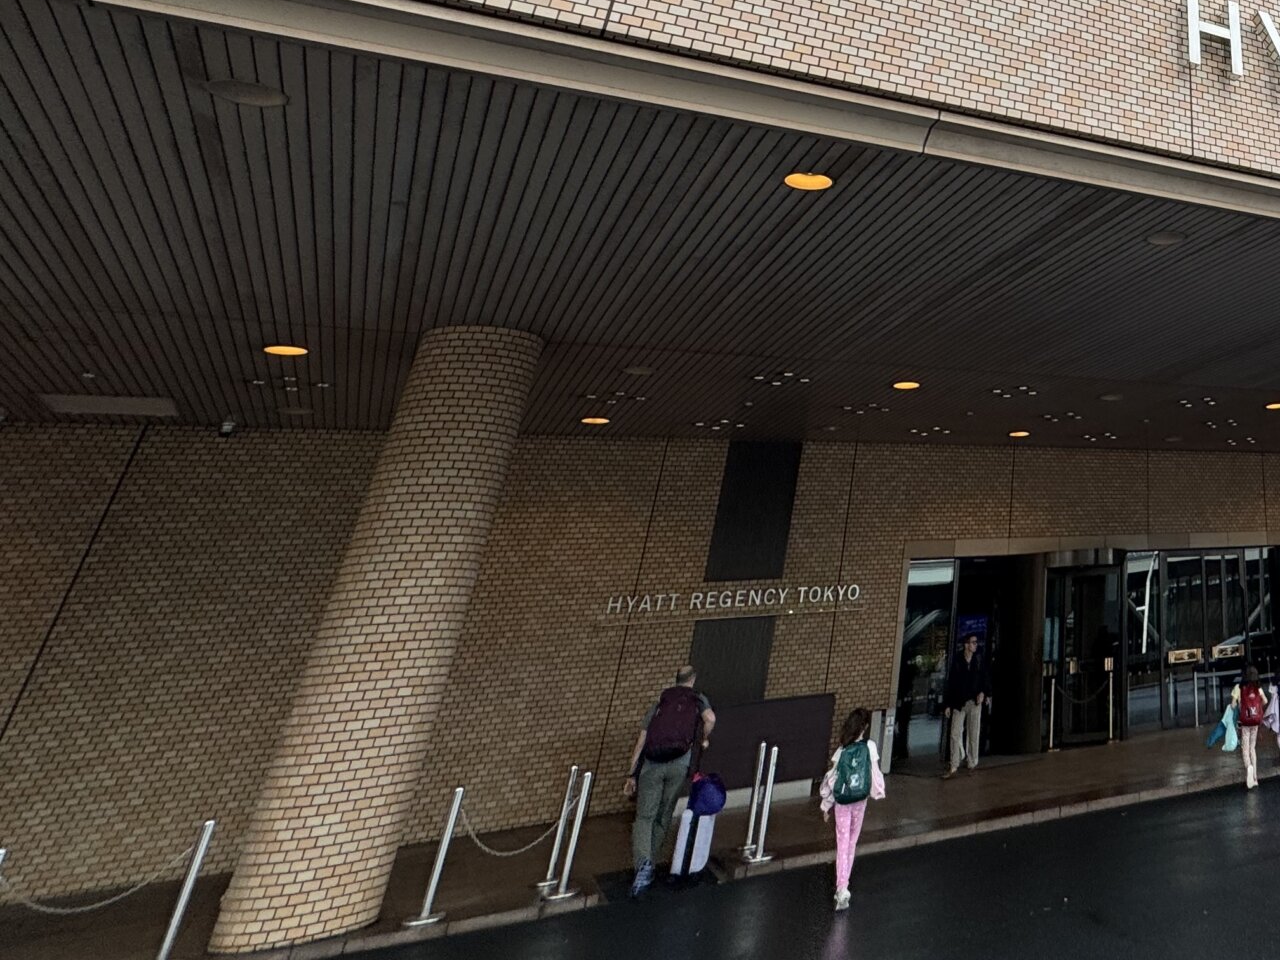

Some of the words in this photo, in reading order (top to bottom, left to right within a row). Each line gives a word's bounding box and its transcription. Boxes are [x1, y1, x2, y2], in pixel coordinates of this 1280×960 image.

[606, 593, 681, 615] HYATT
[689, 587, 790, 611] REGENCY
[797, 583, 861, 604] TOKYO
